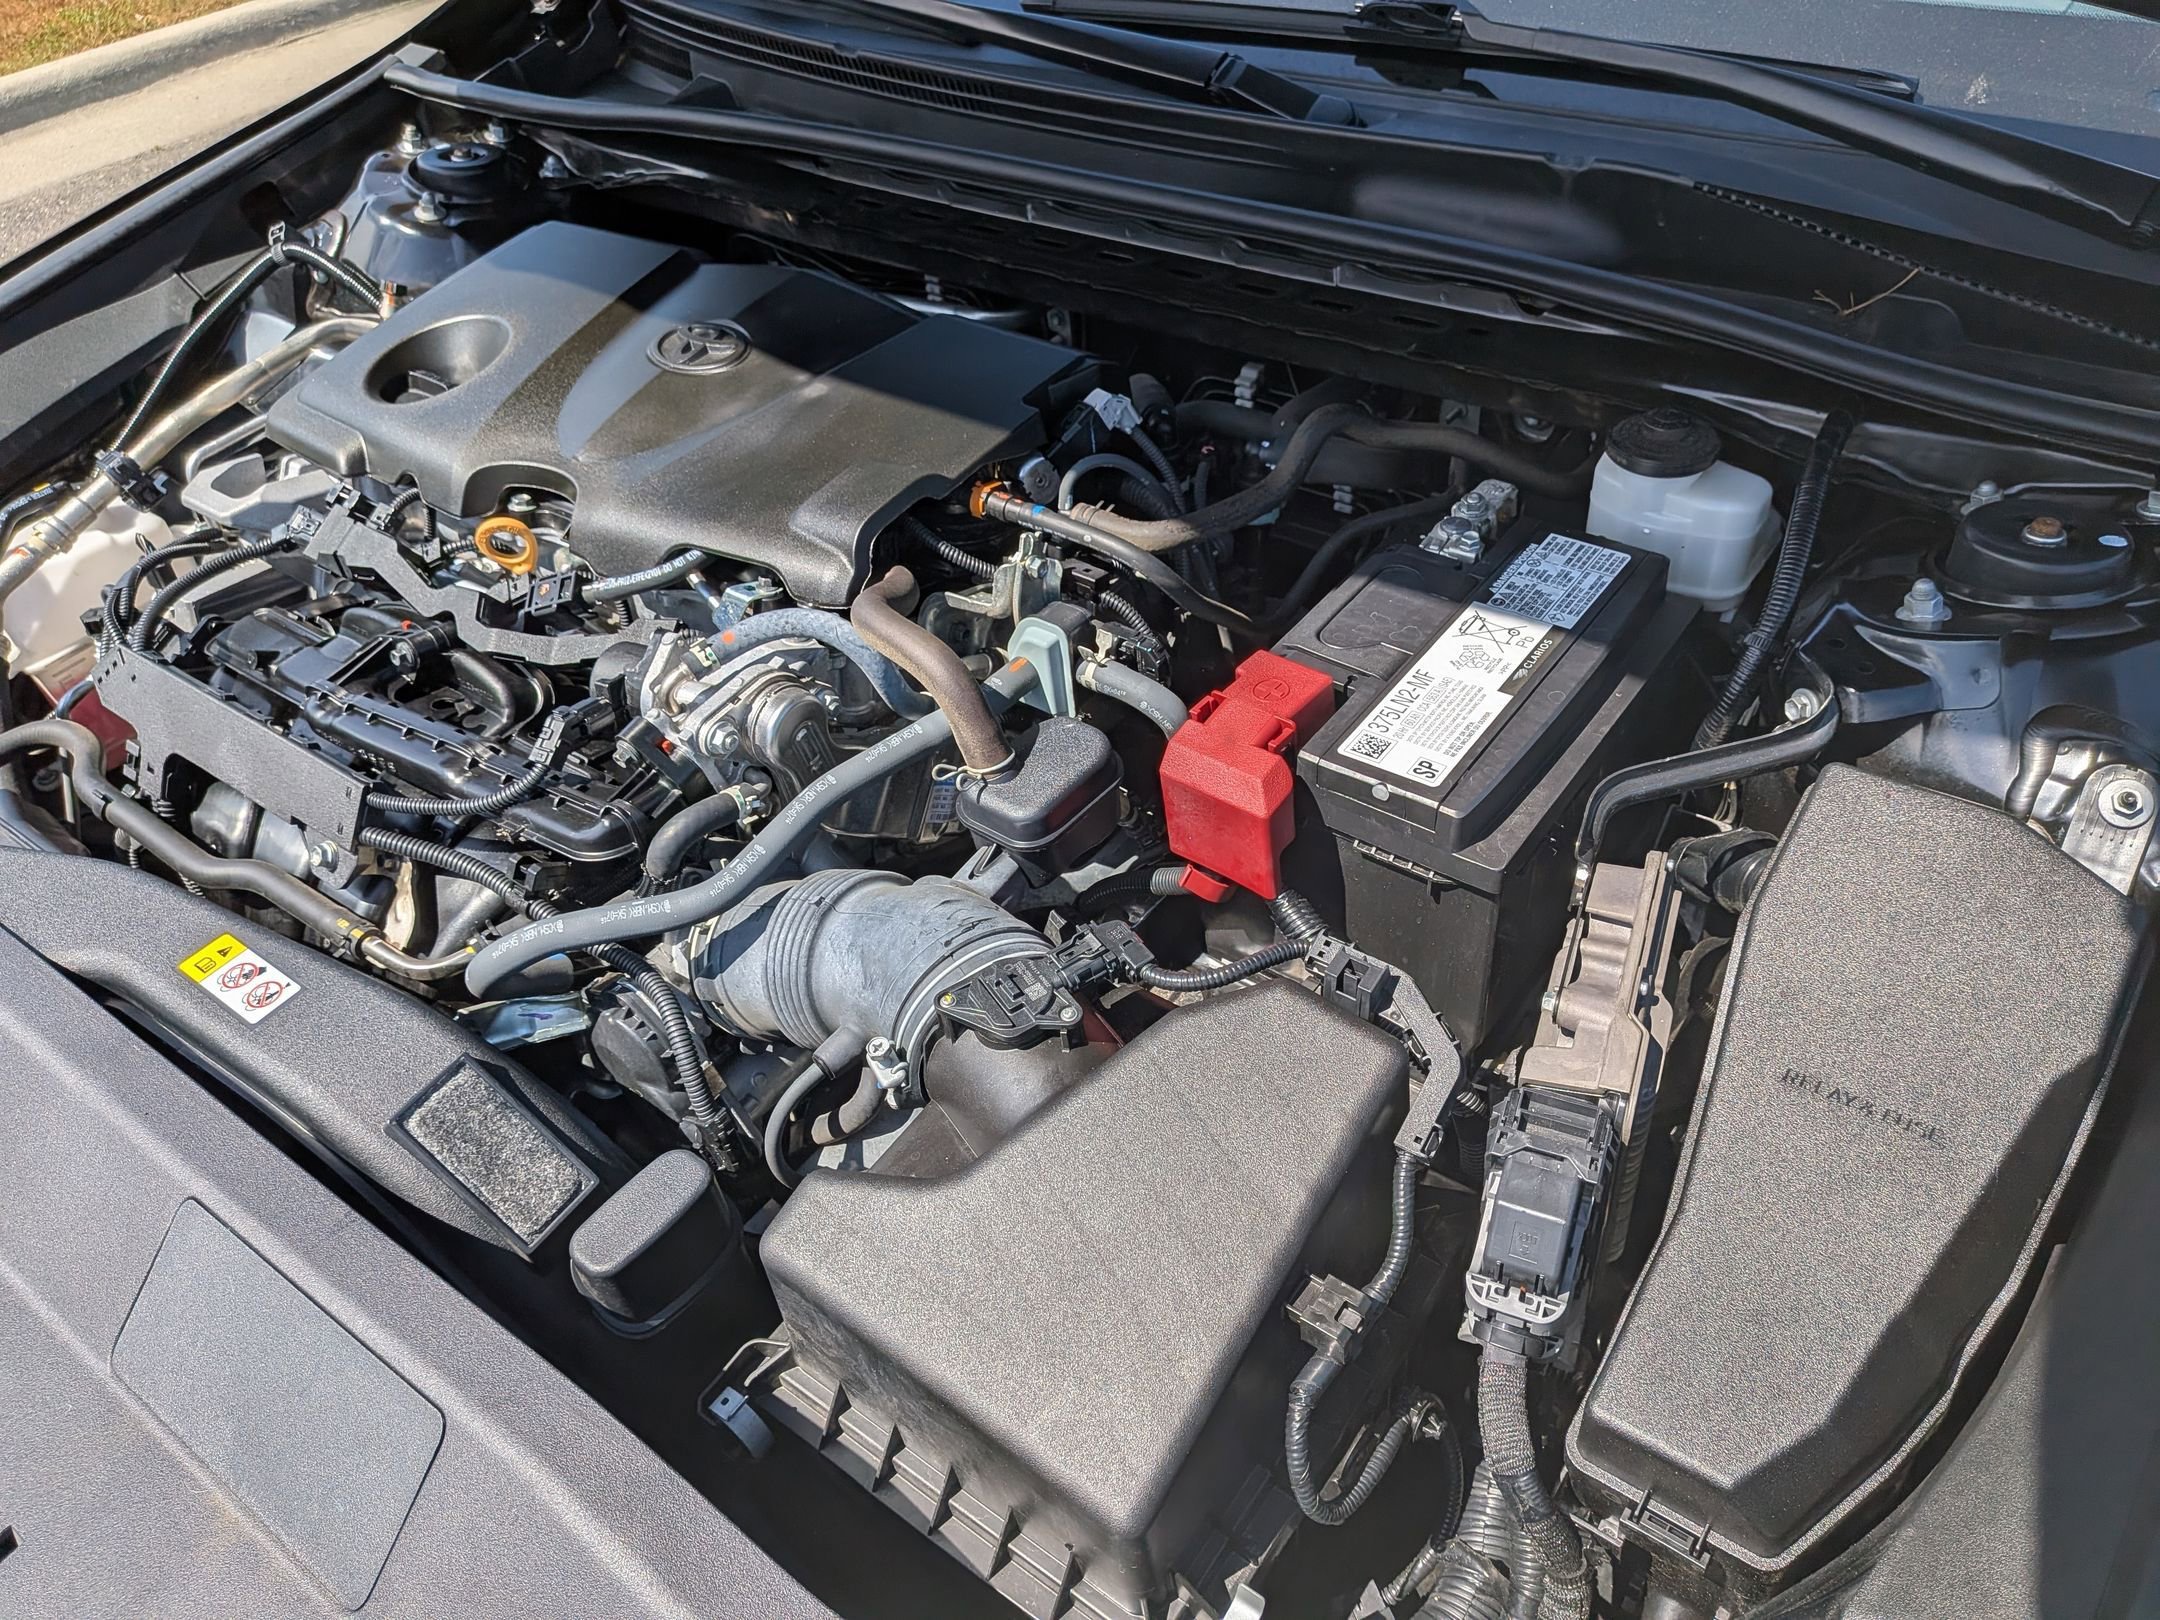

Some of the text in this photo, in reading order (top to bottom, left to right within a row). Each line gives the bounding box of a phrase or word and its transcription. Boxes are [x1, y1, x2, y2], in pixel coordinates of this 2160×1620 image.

[1515, 636, 1535, 649] Pb
[1523, 639, 1553, 669] CLARIOS
[1368, 669, 1433, 733] 375LN2-MF
[1413, 760, 1439, 779] SP
[1780, 1067, 1856, 1106] RELAY
[1881, 1108, 1945, 1142] FUSE
